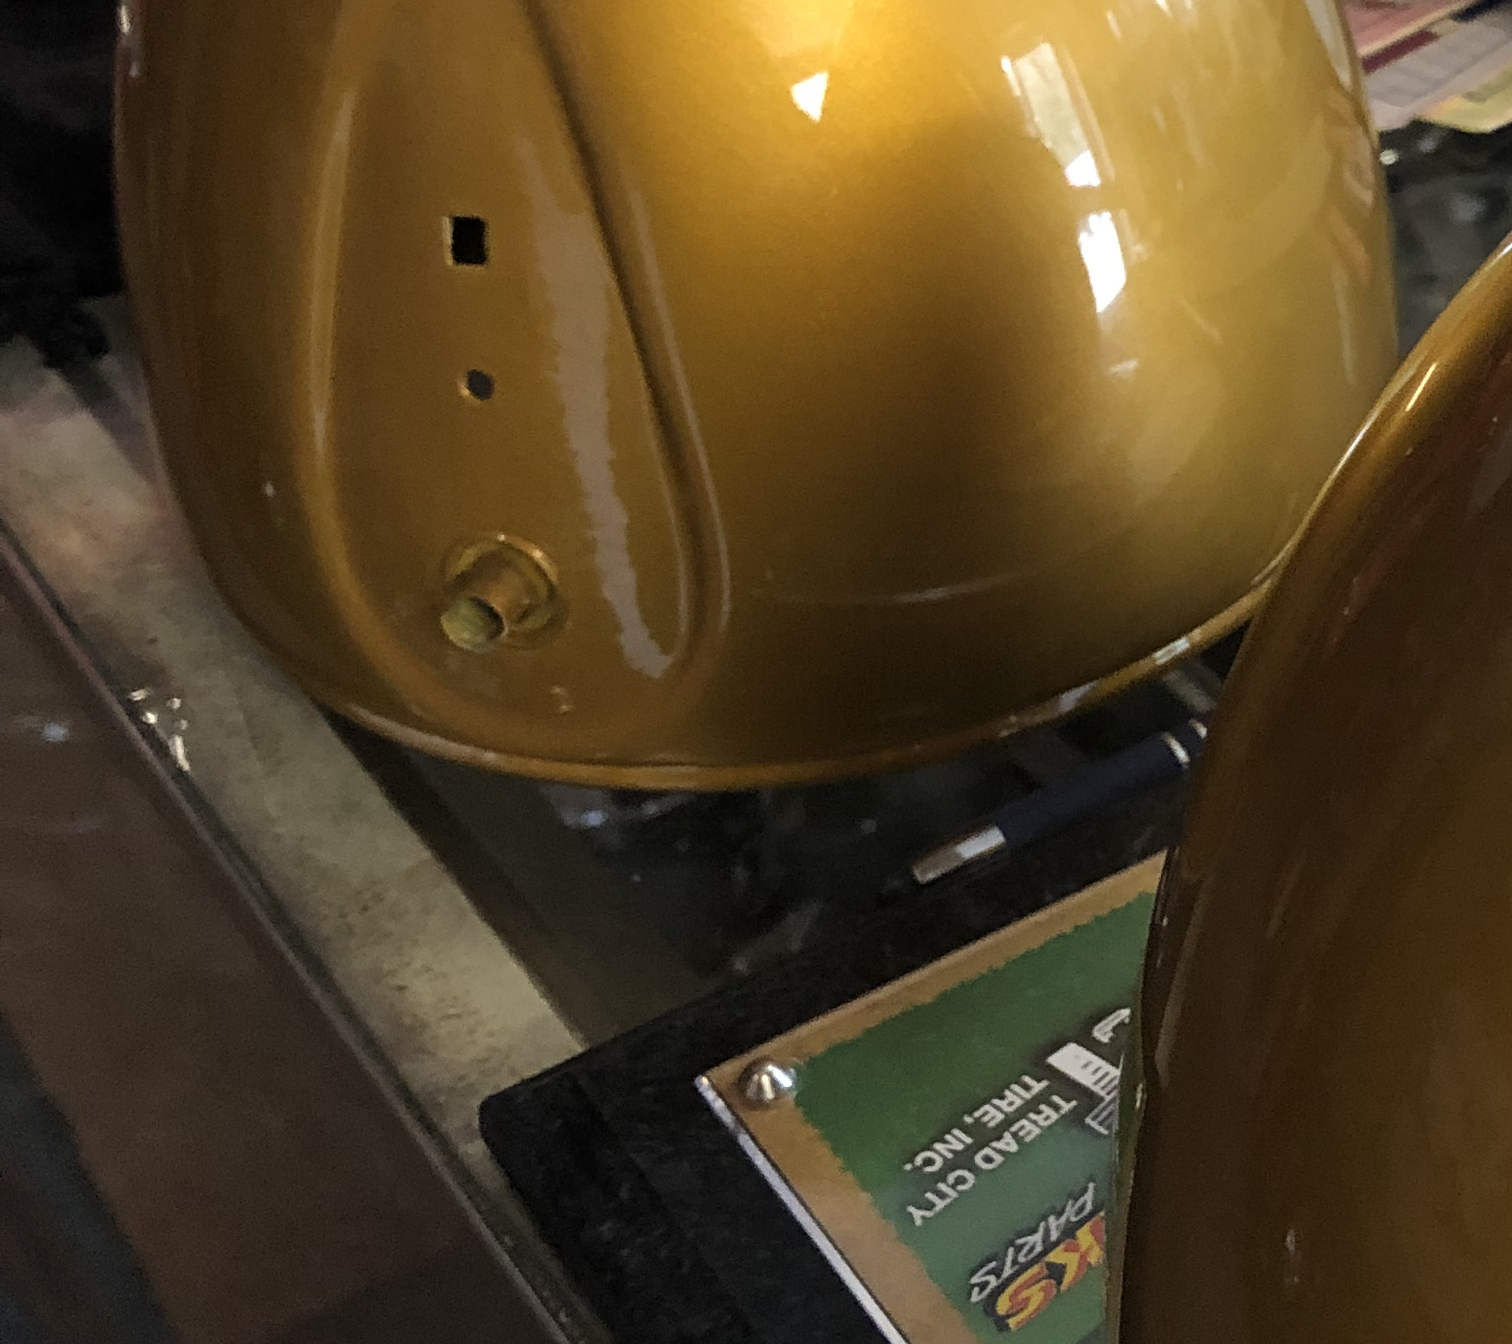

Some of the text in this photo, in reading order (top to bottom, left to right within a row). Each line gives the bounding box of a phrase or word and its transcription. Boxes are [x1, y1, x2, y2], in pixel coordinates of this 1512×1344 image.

[902, 1074, 1051, 1173] TIRE, INC.
[906, 1094, 1078, 1227] TREAD CITY
[968, 1181, 1097, 1304] PARTS
